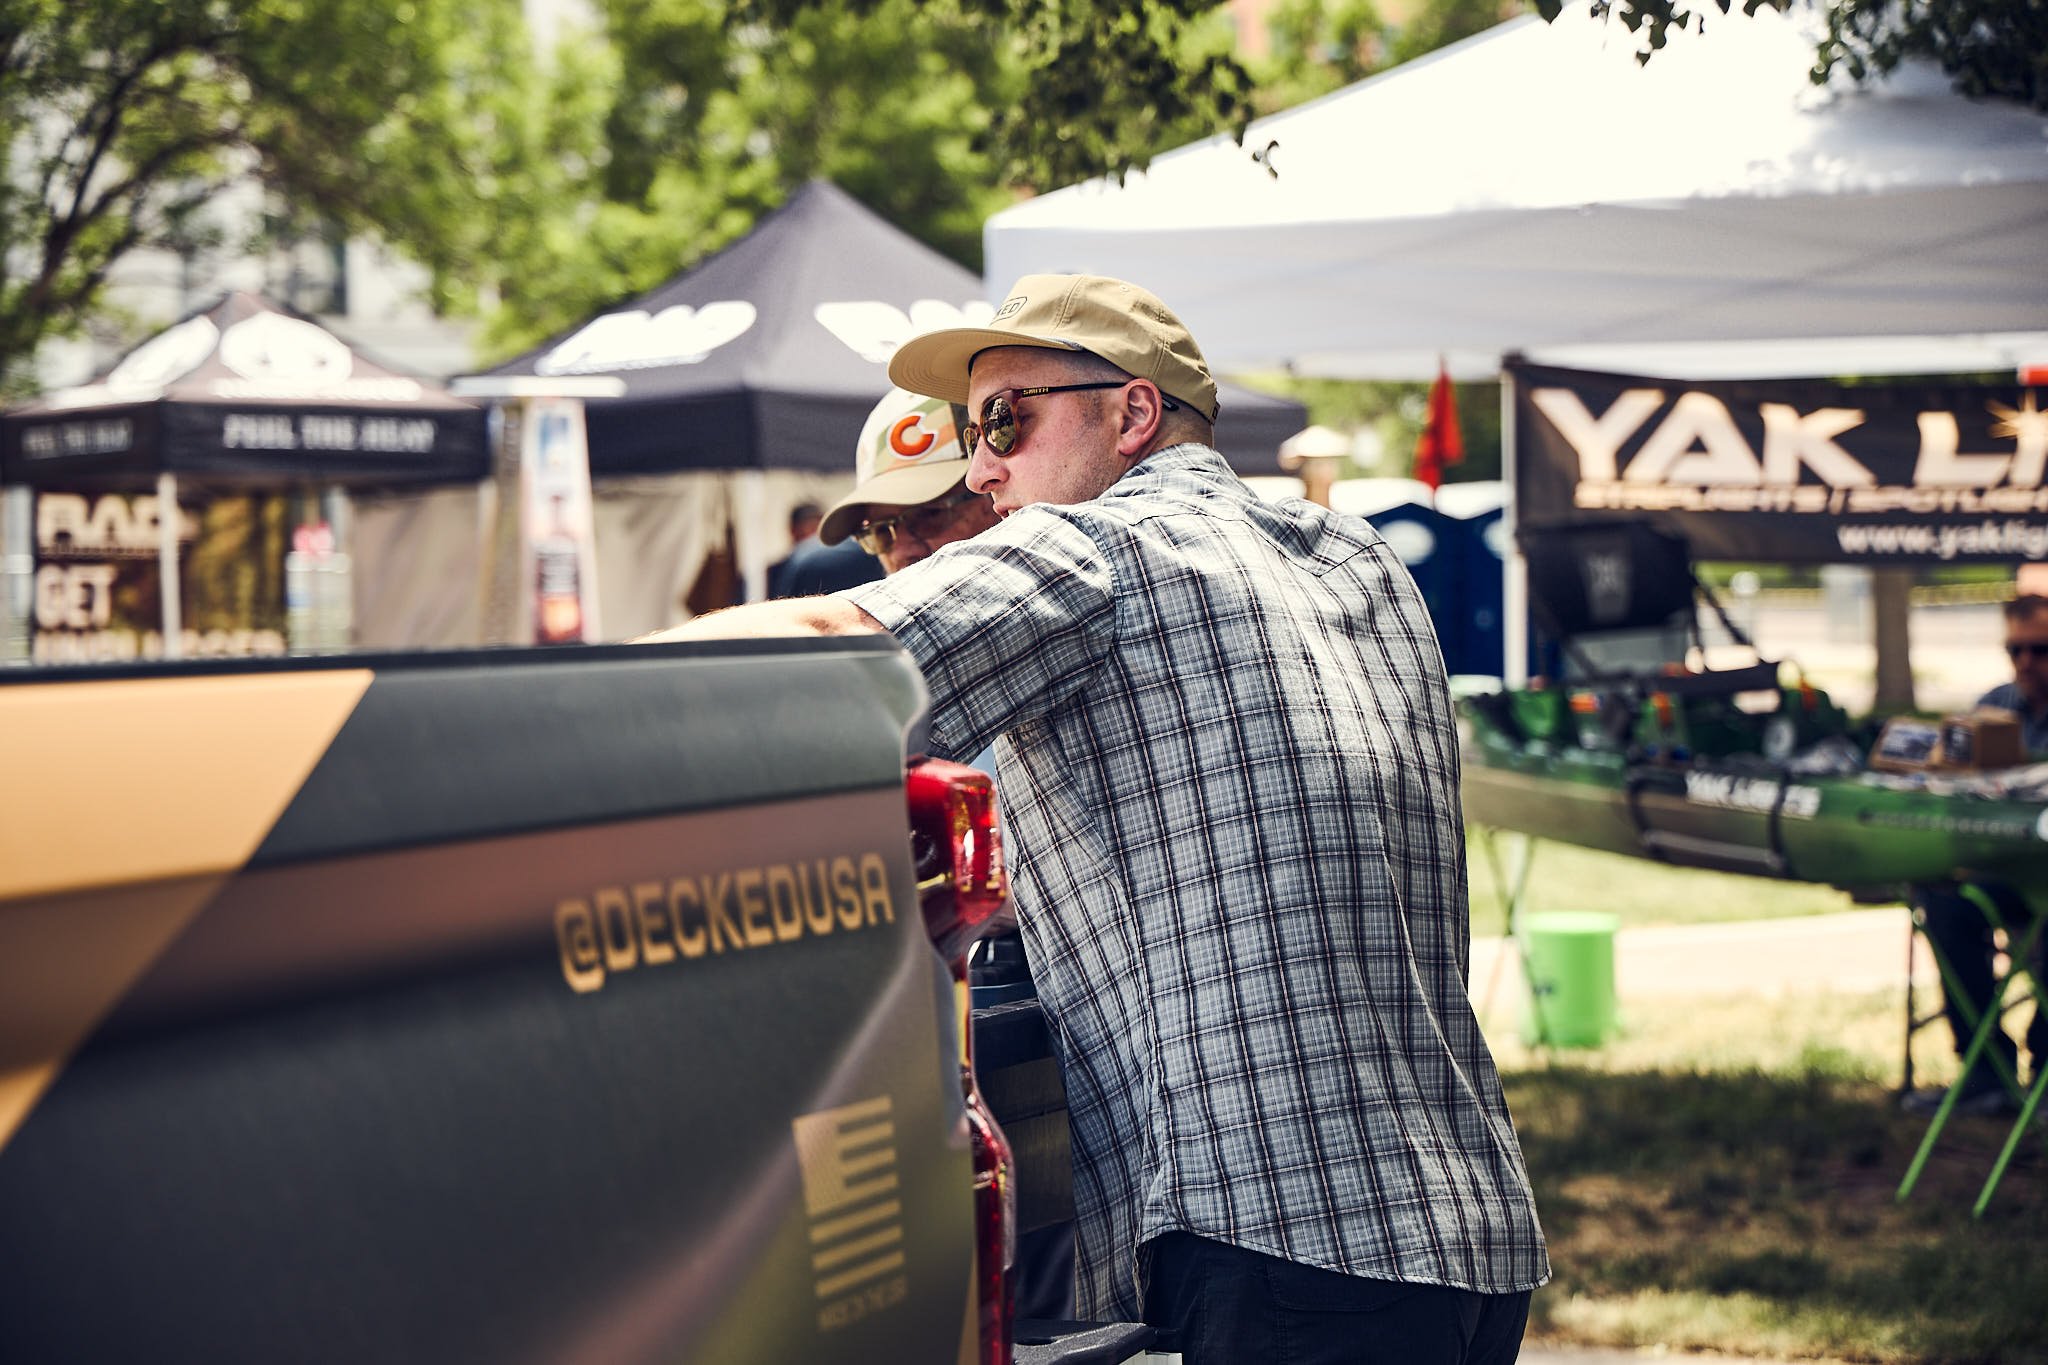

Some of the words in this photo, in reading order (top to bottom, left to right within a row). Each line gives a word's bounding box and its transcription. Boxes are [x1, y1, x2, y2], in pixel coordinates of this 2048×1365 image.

[1023, 387, 1049, 396] SMITH
[1531, 388, 1880, 487] YAK
[1838, 520, 2048, 560] www.yaklig
[35, 563, 117, 631] GET
[554, 852, 896, 993] @DECKEDUSA
